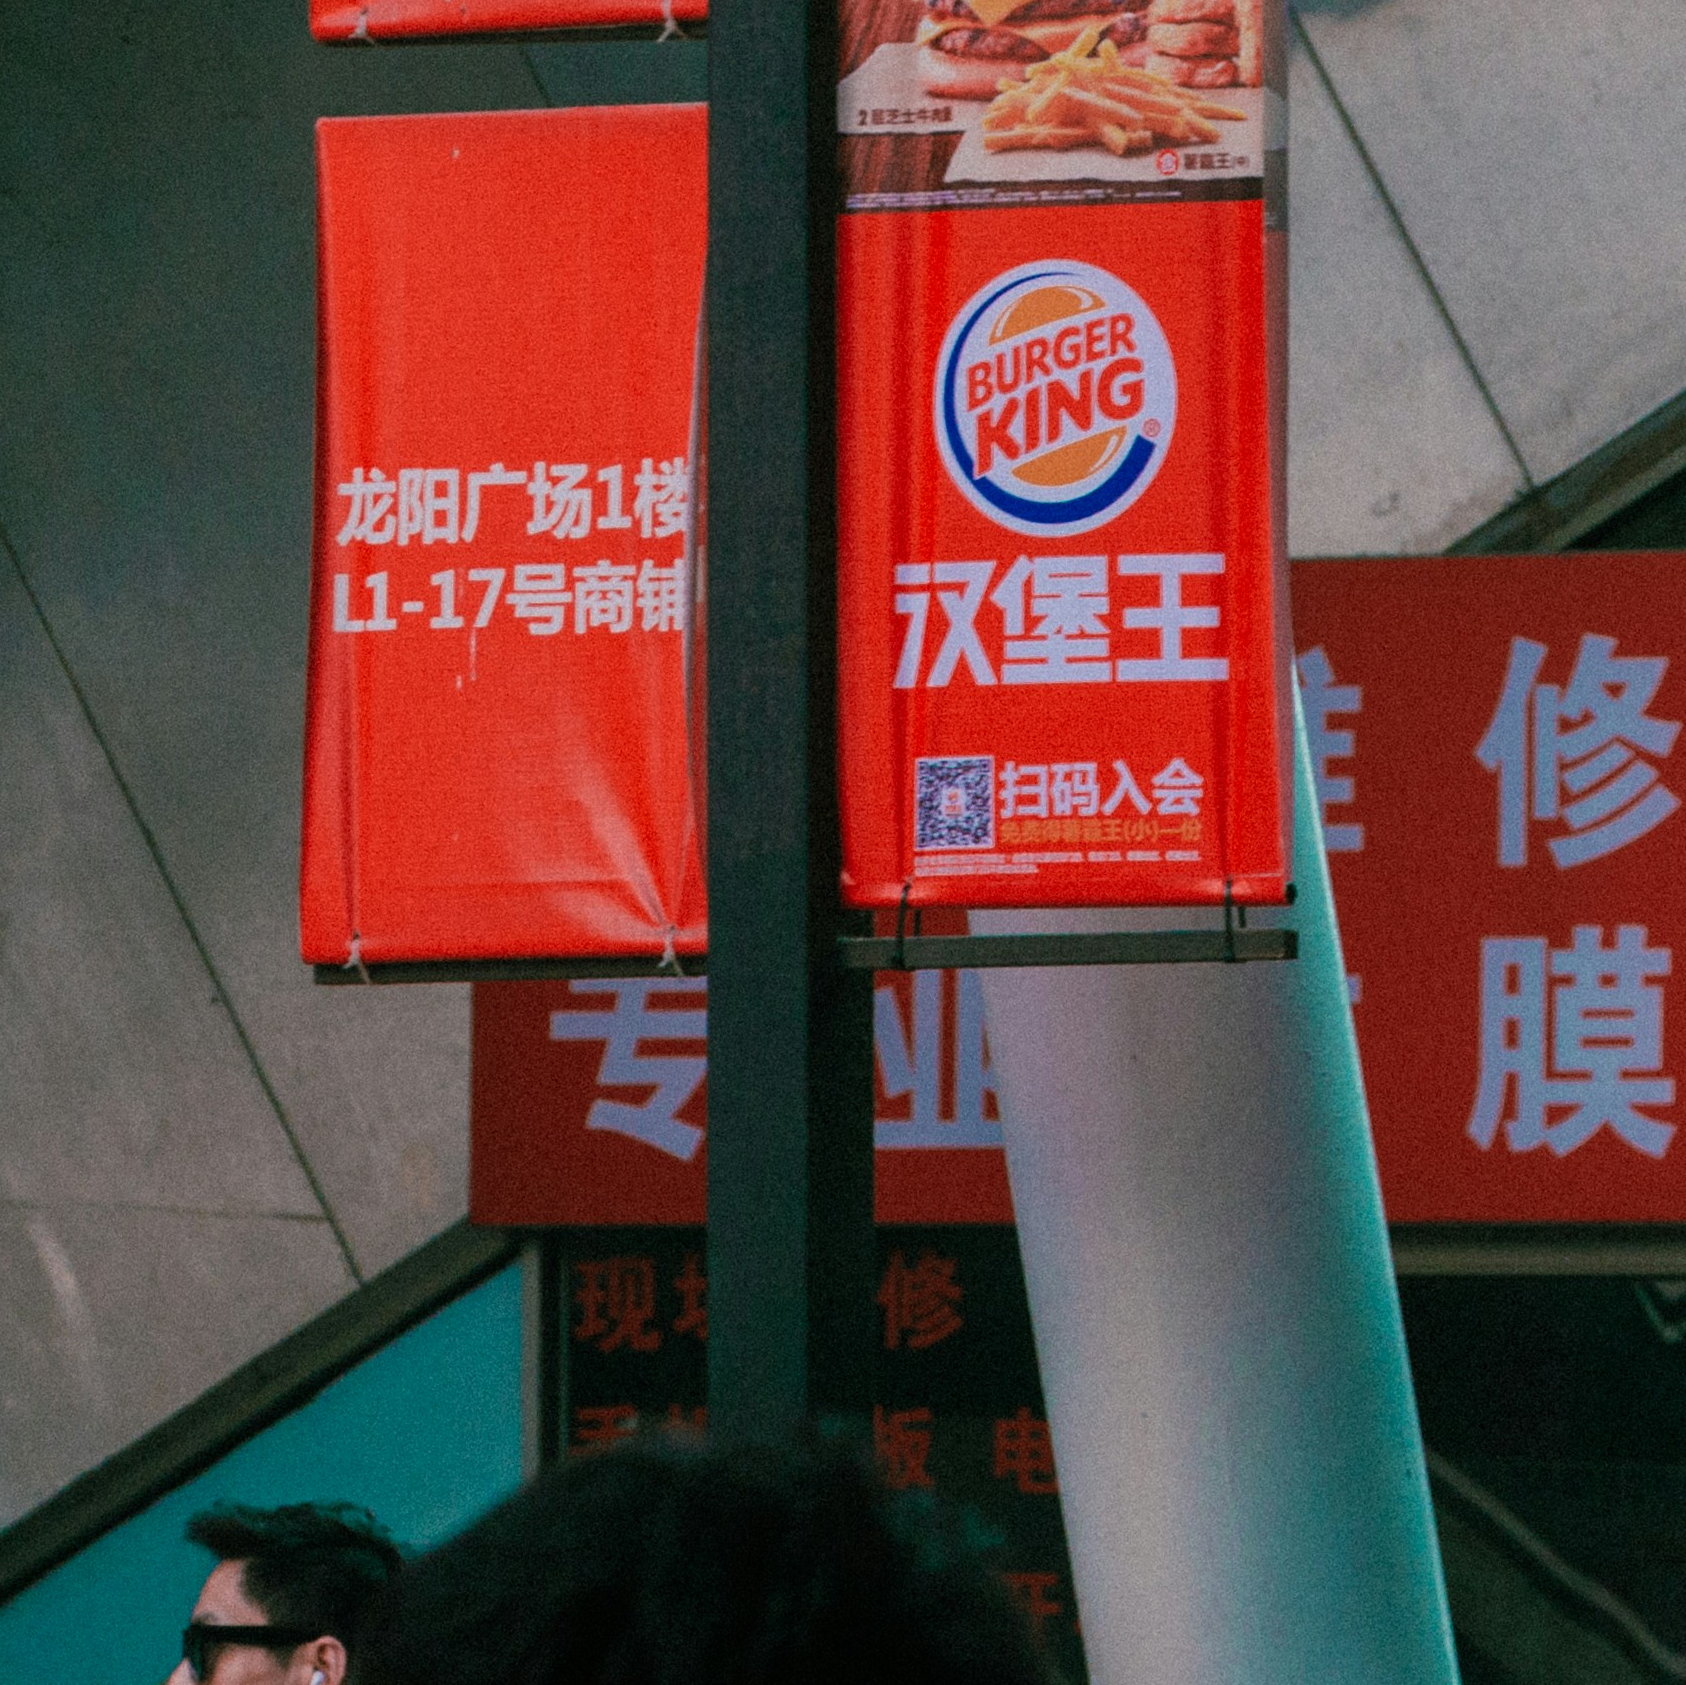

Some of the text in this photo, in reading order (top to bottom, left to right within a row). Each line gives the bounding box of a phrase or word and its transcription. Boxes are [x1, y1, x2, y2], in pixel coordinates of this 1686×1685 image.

[966, 312, 1139, 414] BURGER
[973, 357, 1146, 481] KING
[335, 457, 690, 546] 龙阳广场1楼
[893, 553, 1230, 689] 汉堡王
[999, 757, 1205, 818] 扫码入会
